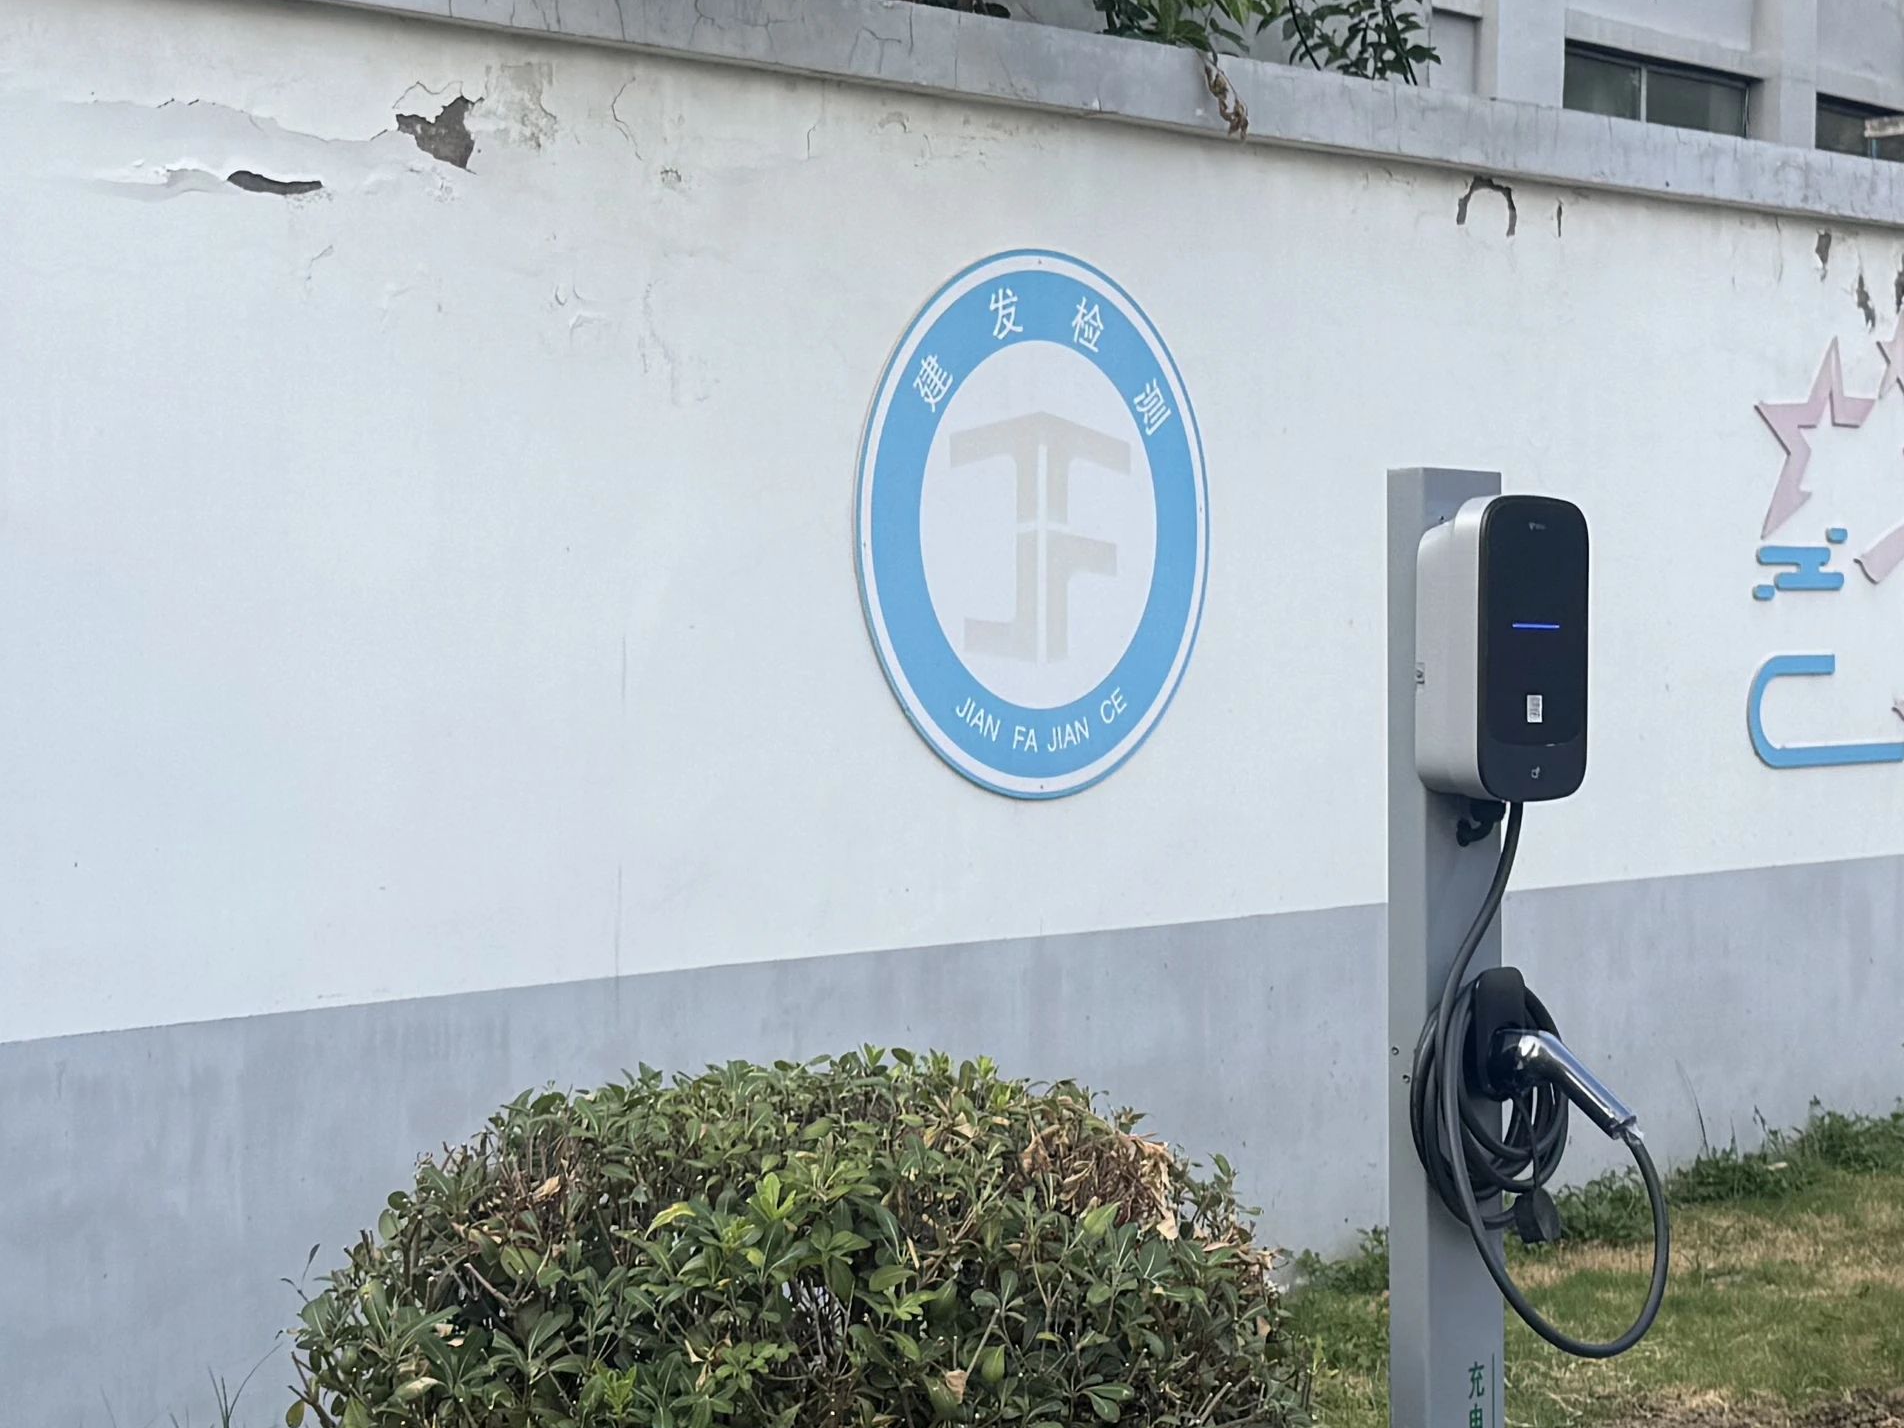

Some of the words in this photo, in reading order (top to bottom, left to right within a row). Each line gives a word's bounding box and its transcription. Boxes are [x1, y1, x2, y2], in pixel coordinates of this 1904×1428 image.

[913, 286, 1172, 436] 建发检测
[955, 695, 1002, 742] JIAN
[1012, 726, 1038, 753] FA
[1046, 721, 1090, 753] JIAN
[1099, 685, 1127, 725] CE
